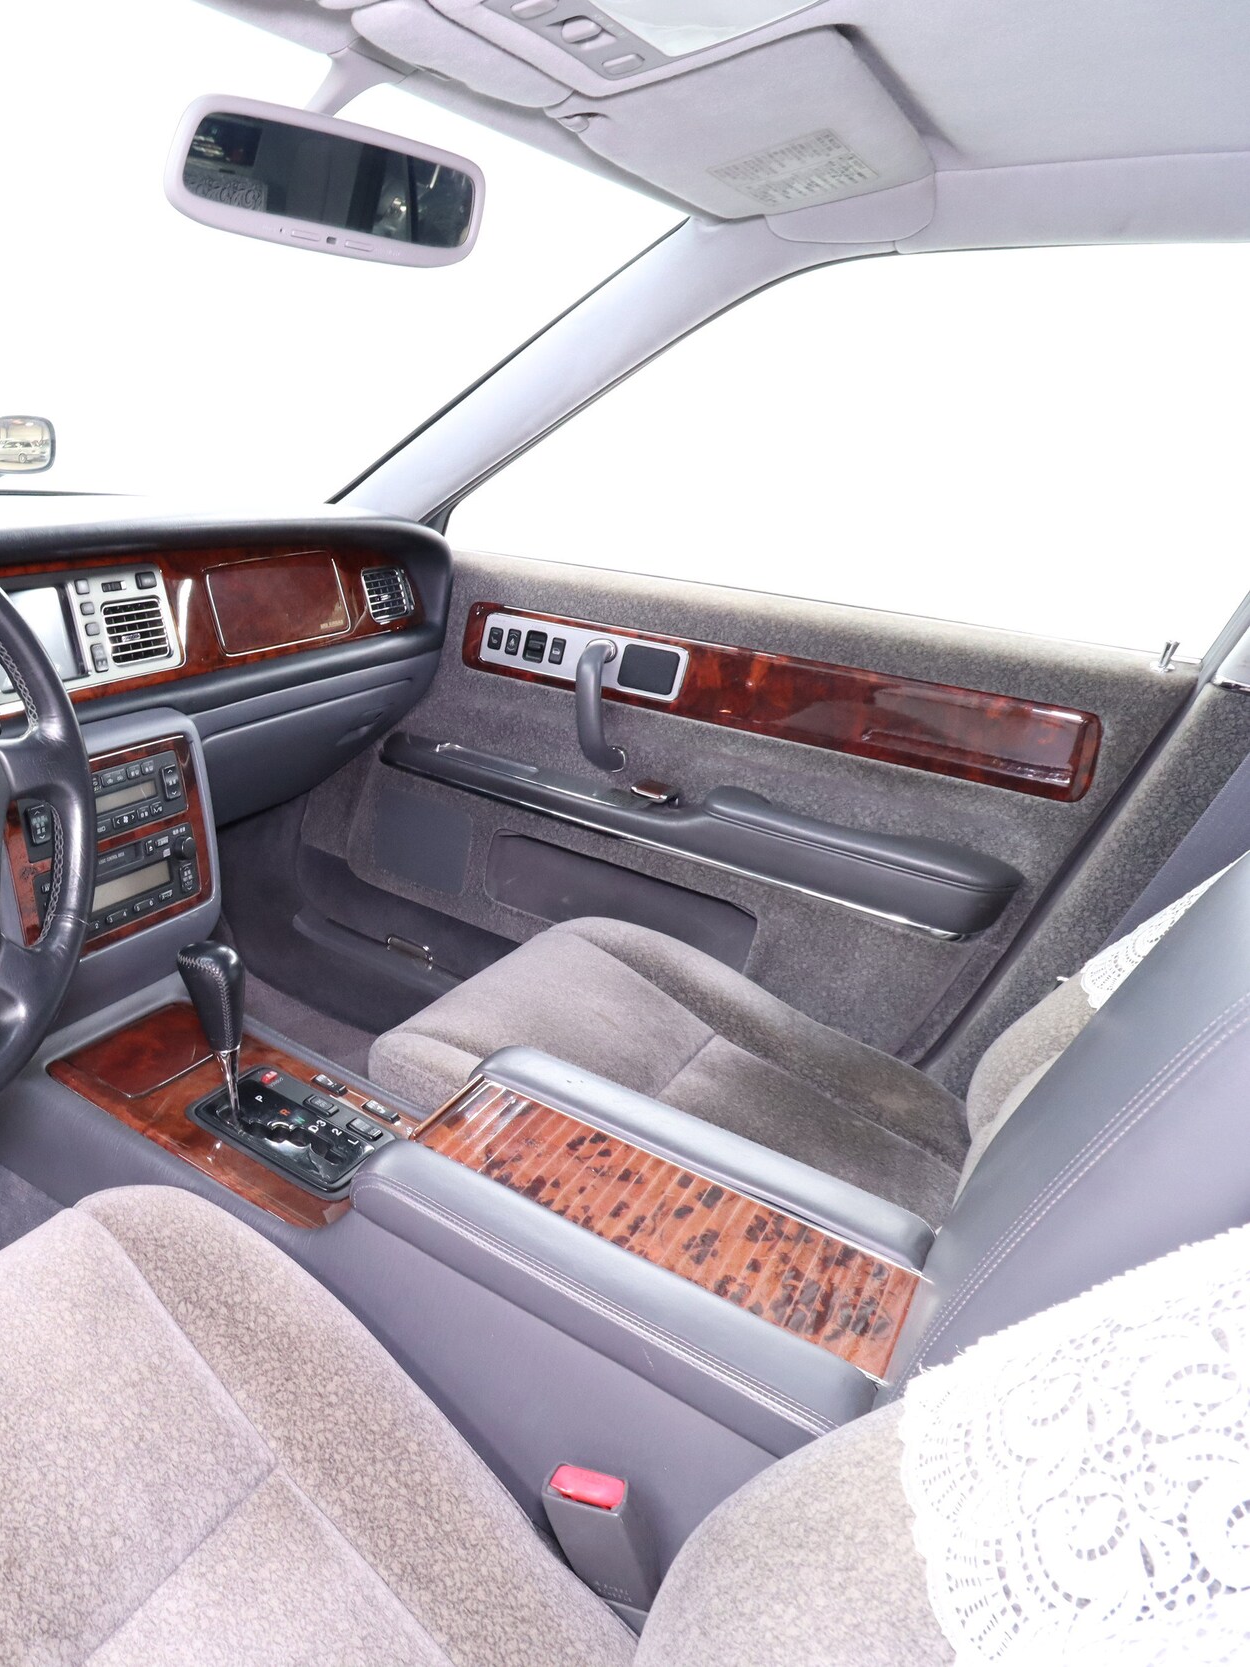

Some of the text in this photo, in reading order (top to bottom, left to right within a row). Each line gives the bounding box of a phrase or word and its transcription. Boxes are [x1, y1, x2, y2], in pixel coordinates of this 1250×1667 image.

[254, 1094, 263, 1103] P
[279, 1108, 291, 1117] R
[294, 1115, 306, 1124] N
[331, 1128, 343, 1136] 2
